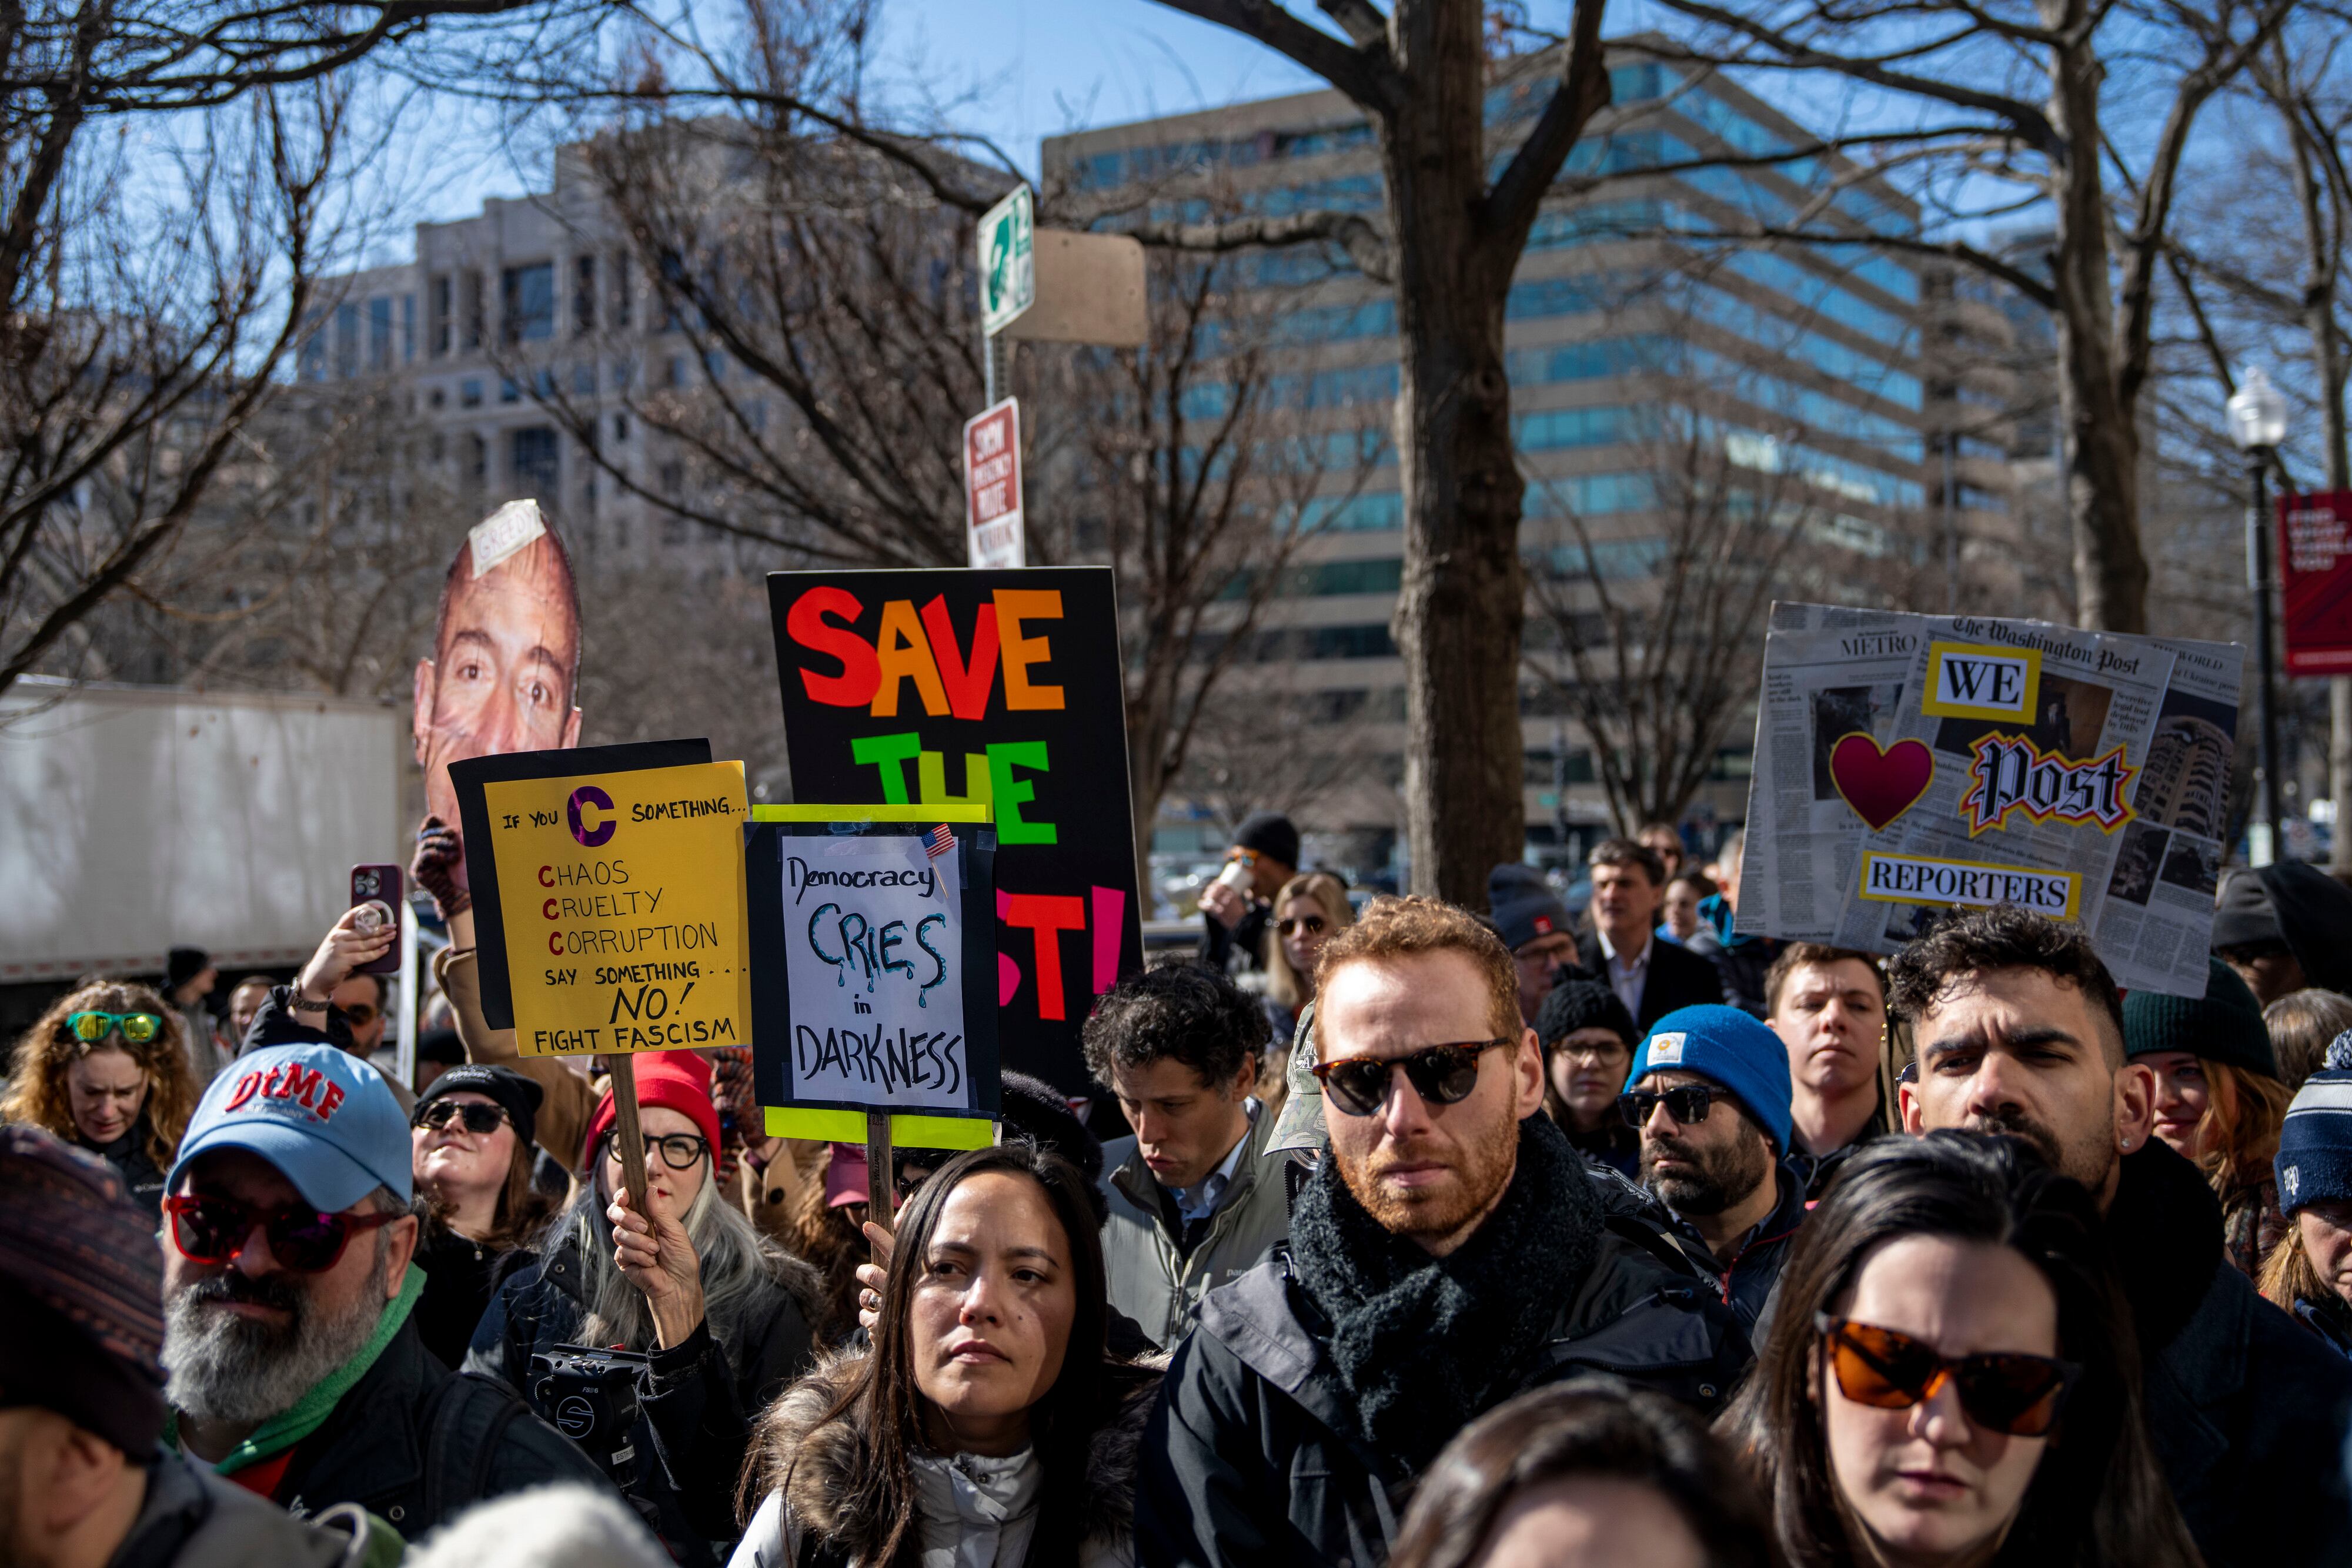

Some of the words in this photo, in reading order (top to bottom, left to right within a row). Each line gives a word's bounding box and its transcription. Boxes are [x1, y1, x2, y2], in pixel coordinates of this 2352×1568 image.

[787, 586, 1065, 721] SAVE
[1841, 634, 1917, 657] METRO
[1953, 617, 1984, 637] The
[1988, 620, 2093, 664] Washington
[2097, 648, 2140, 676] Post
[1944, 658, 2021, 704] WE
[851, 732, 1057, 844] THE
[1972, 742, 2122, 821] Post
[503, 814, 520, 829] IF
[529, 811, 558, 827] YOU
[567, 785, 617, 847] C
[538, 860, 629, 888] CHAOS
[787, 856, 935, 907] Democracy
[1871, 861, 2066, 908] REPORTERS
[542, 887, 663, 920] CRUELTY
[548, 922, 718, 955] CORRUPTION
[808, 902, 947, 994] CRIES
[545, 968, 577, 986] SAY
[609, 981, 694, 1024] NO!
[854, 994, 872, 1014] in
[534, 1029, 600, 1053] FIGHT
[615, 1018, 736, 1049] FASCISM
[796, 1023, 963, 1094] DARKNESS
[225, 1062, 345, 1122] DtMF
